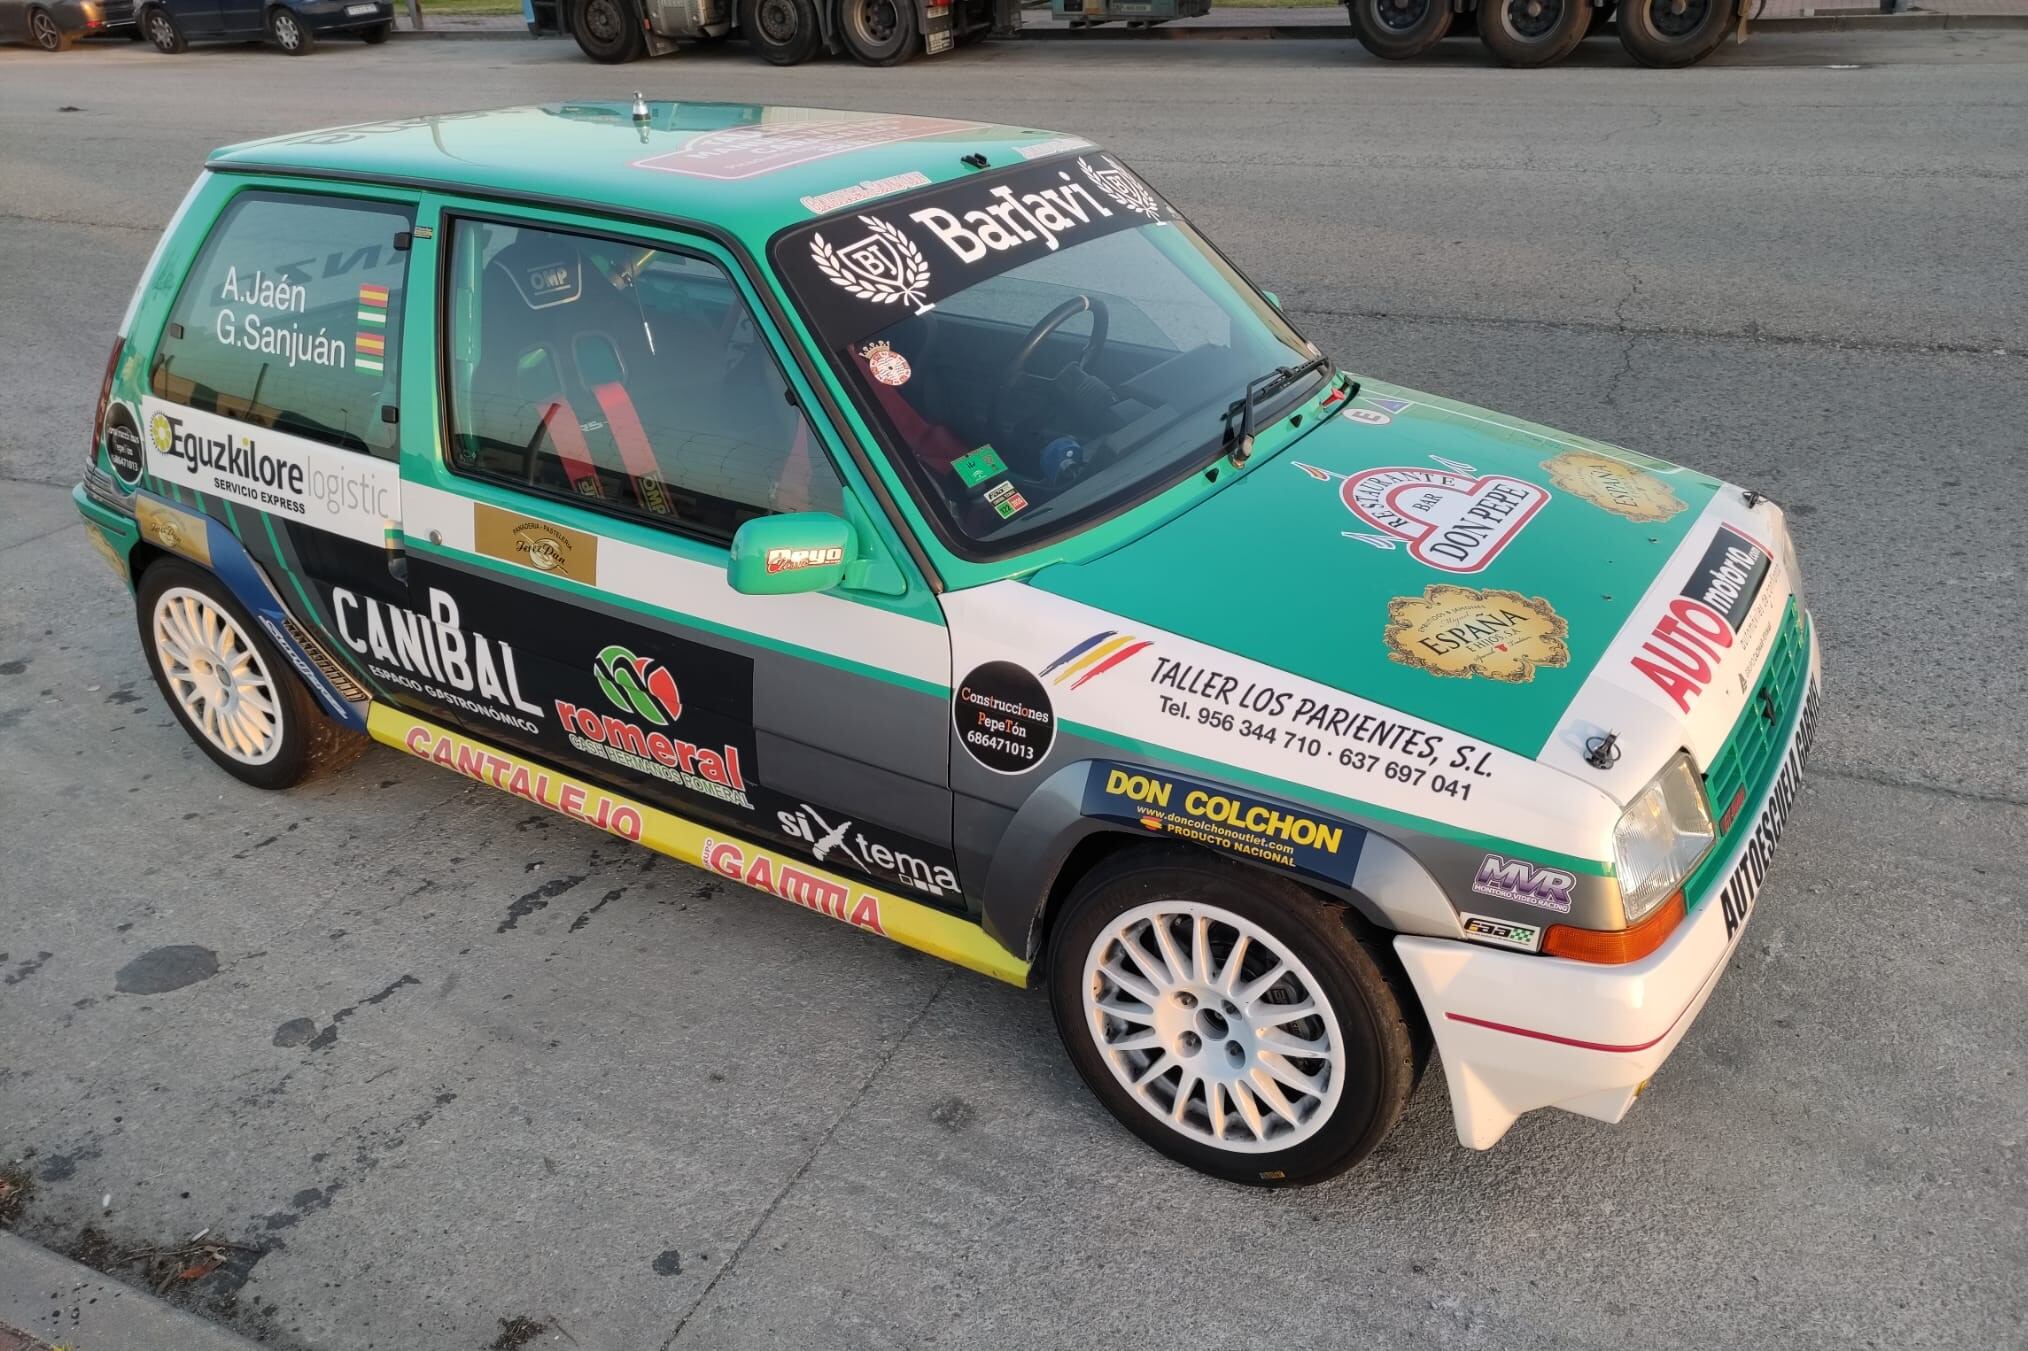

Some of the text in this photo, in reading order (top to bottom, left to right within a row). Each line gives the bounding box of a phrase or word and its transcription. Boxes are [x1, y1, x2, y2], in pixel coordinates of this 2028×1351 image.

[529, 267, 569, 290] OMP
[852, 236, 897, 278] BJ
[220, 265, 307, 314] A.Jaén
[215, 309, 347, 370] G.Sanjuán
[166, 413, 390, 520] Eguzkilore logistic
[213, 477, 306, 515] SERVICIO EXPRESS
[1353, 470, 1457, 530] RESTAURANTE
[1412, 492, 1443, 513] BAR
[1430, 483, 1530, 563] DON PEPE
[1418, 609, 1529, 656] ESPAÑA
[1630, 598, 1733, 715] AUTO
[367, 663, 424, 696] ESPACIO
[424, 681, 540, 735] GASTRONÓMICO
[960, 687, 1050, 724] Construcciones
[978, 711, 1027, 738] PepeTón
[1150, 656, 1495, 778] TALLER LOS PARIENTES, S.L.
[555, 699, 746, 792] romeral
[568, 733, 755, 810] CASH HERMANOS ROMERAL
[966, 730, 1035, 760] 686471013
[1159, 694, 1191, 722] Tel.
[1197, 706, 1236, 734] 956
[1238, 717, 1279, 745] 344
[1284, 731, 1322, 758] 710
[1338, 746, 1381, 774] 637
[1384, 760, 1428, 788] 697
[1431, 773, 1474, 802] 041
[404, 725, 645, 842] CANTALEJO
[1106, 768, 1344, 855] DON COLCHON
[1136, 804, 1295, 856] www.doncolchonoutlet.com
[1166, 822, 1297, 868] PRODUCTO NACIONAL
[1719, 748, 1802, 943] AUTOESCUELA
[1477, 857, 1572, 903] MVR
[1512, 893, 1538, 905] VIDEO
[1537, 899, 1568, 912] RACING
